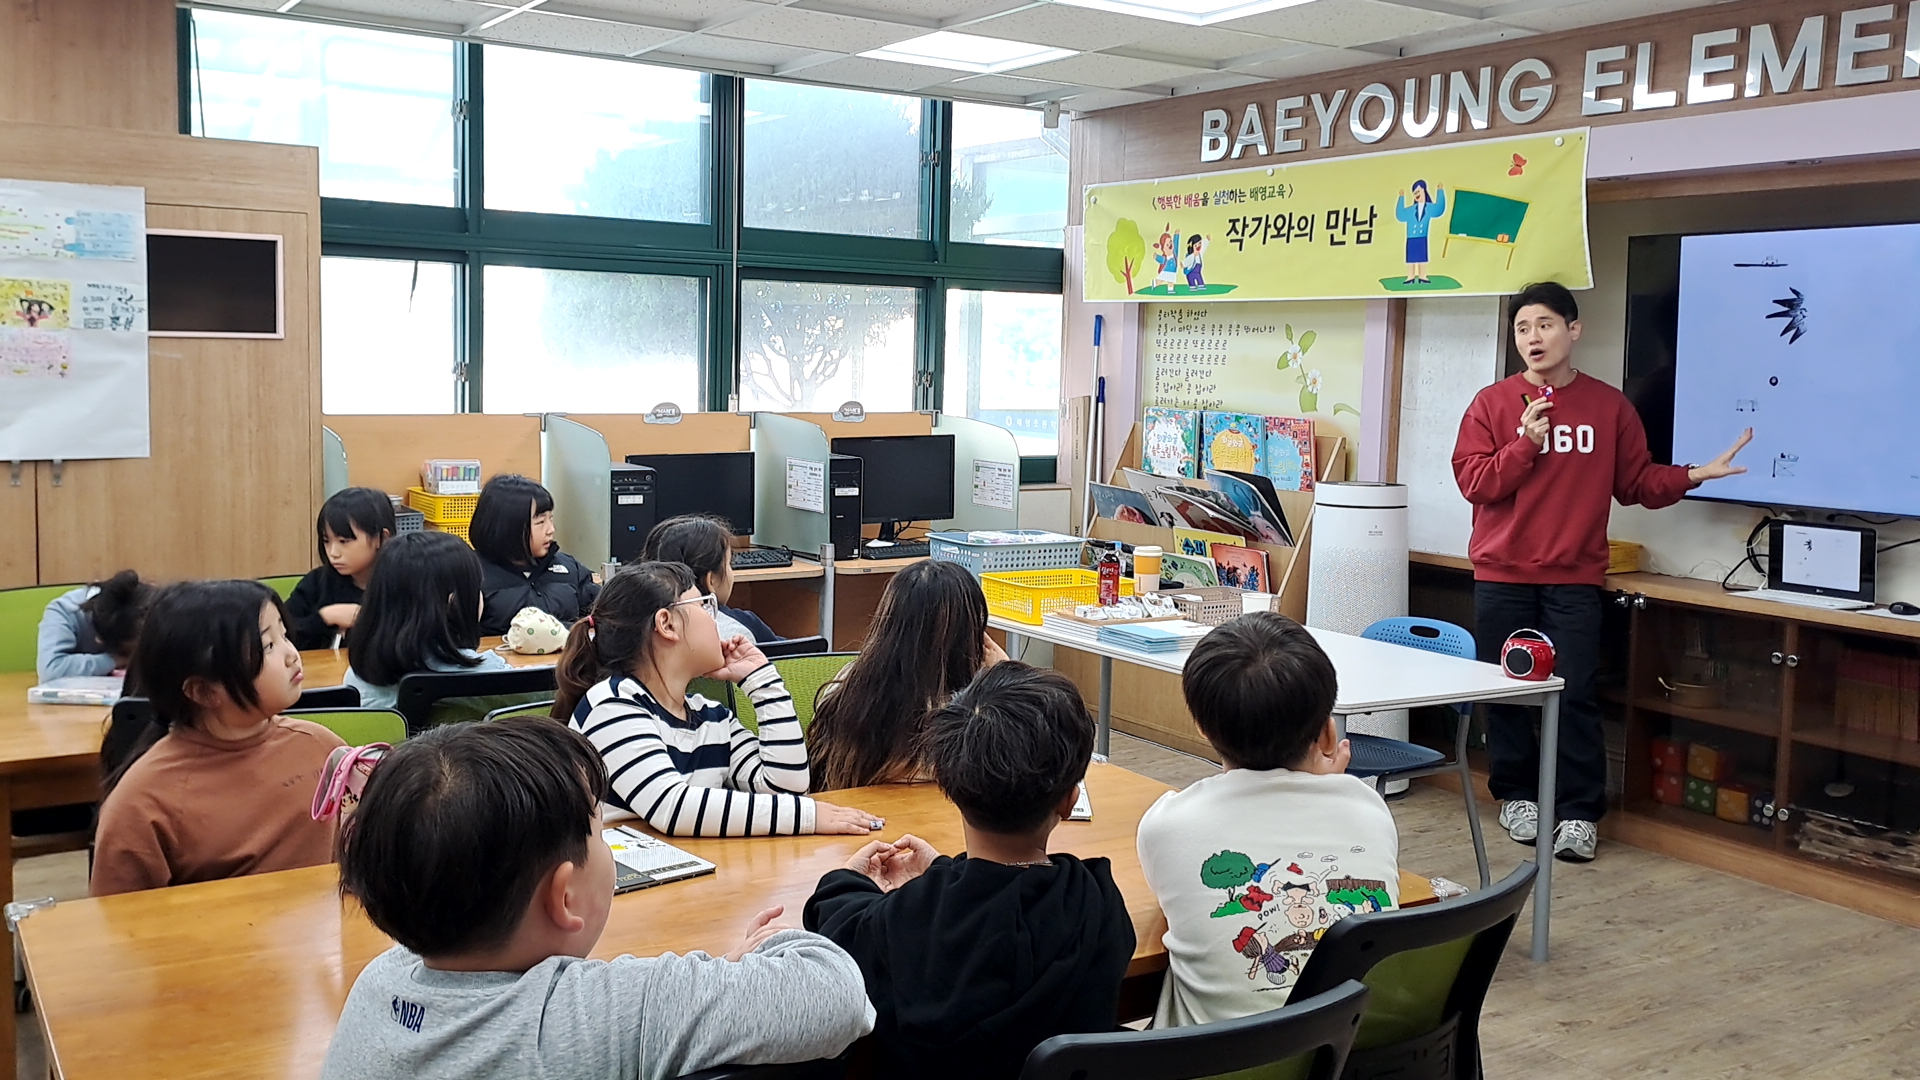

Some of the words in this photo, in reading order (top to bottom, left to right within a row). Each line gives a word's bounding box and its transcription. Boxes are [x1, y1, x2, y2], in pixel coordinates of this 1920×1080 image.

[1200, 57, 1556, 163] BAEYOUNG
[1184, 191, 1209, 208] 배움을
[1212, 188, 1247, 206] 실천하는
[1226, 212, 1315, 251] 작가와의
[1325, 205, 1378, 246] 만남
[1516, 424, 1595, 454] 60
[1257, 903, 1281, 921] POW!
[399, 1000, 426, 1034] NBA
